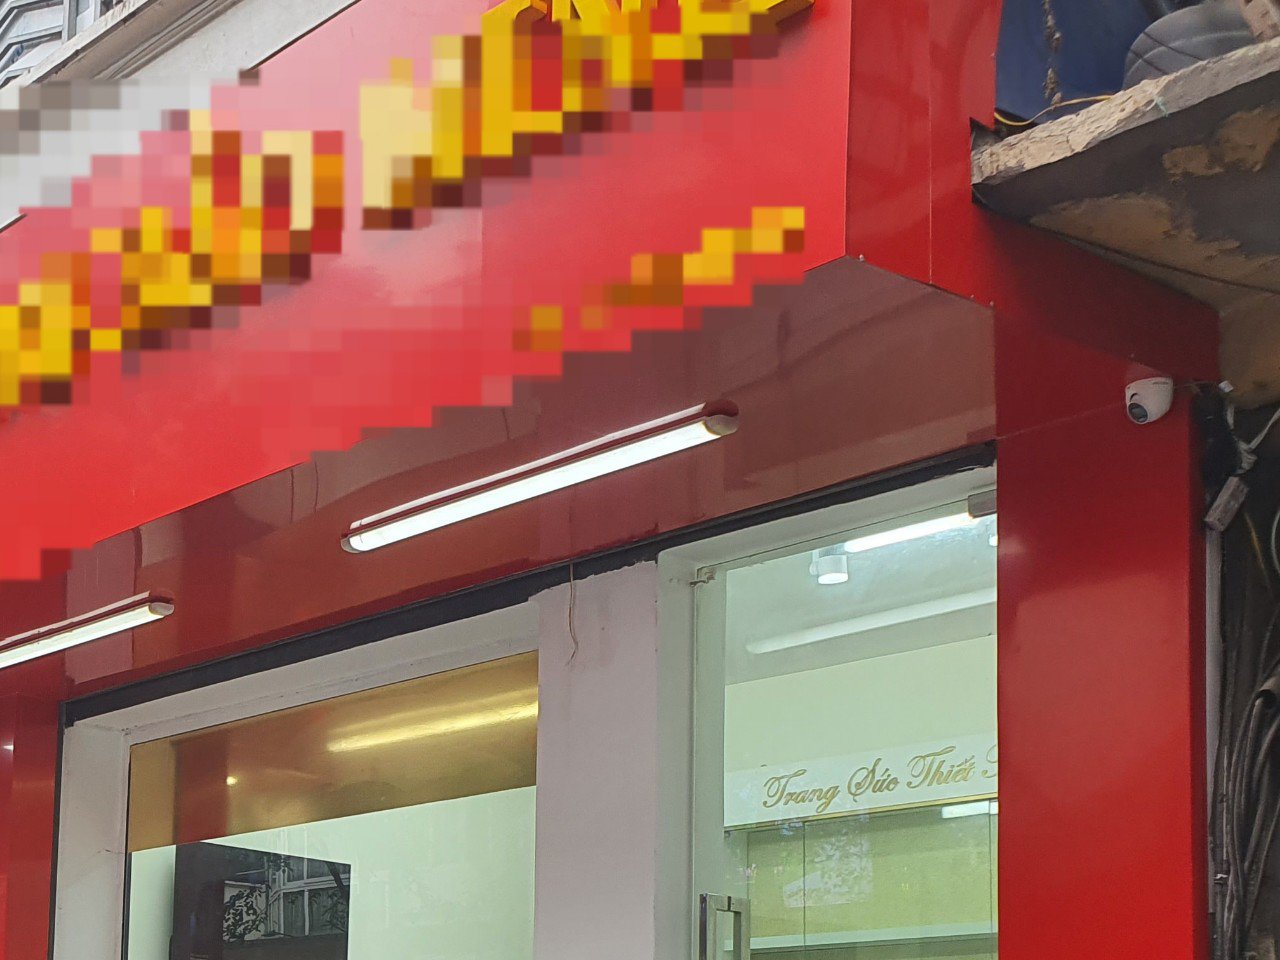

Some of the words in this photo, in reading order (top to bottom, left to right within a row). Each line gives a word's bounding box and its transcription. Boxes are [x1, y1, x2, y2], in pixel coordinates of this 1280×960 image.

[762, 768, 840, 813] Trang
[847, 757, 900, 803] Sức
[905, 745, 977, 790] Thiết
